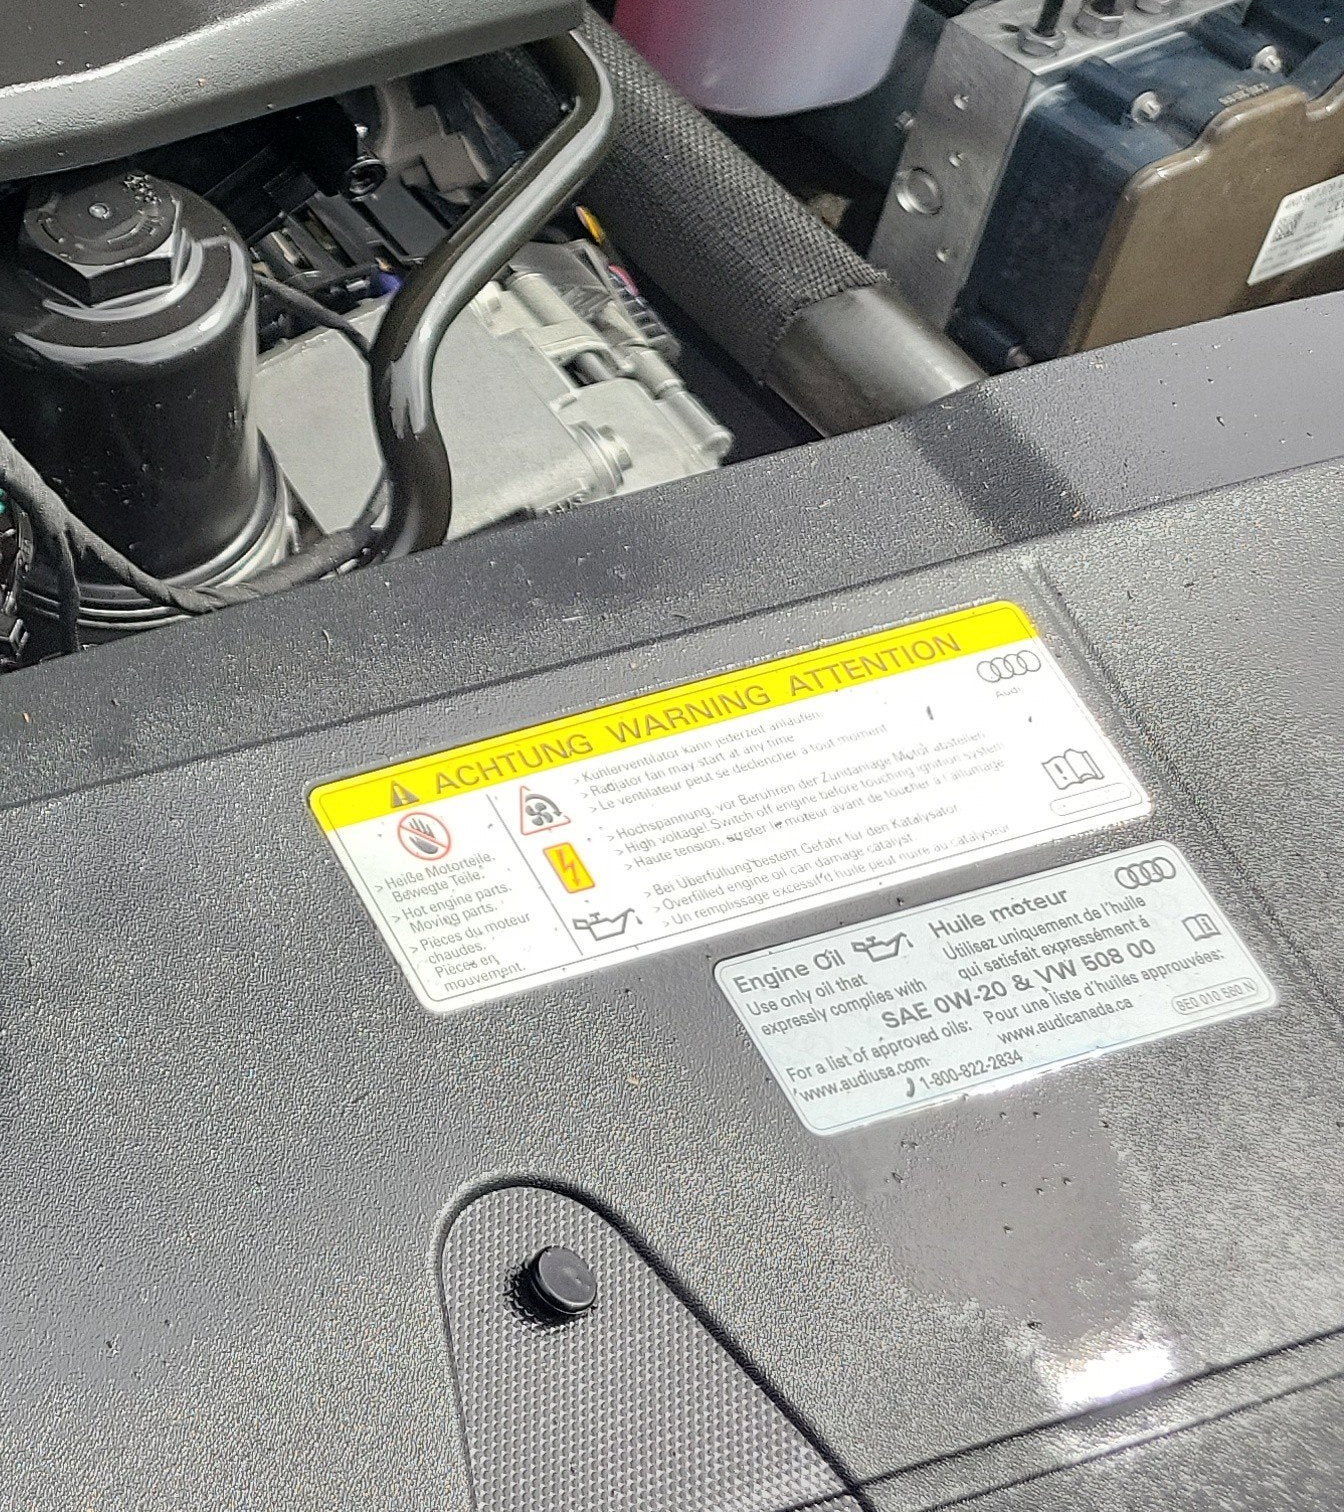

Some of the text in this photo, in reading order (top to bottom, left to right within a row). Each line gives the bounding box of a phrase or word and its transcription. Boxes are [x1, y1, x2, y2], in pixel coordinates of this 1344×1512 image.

[435, 632, 962, 795] ACHTUNG WARNING ATTENTION
[643, 769, 666, 781] fan
[666, 761, 695, 775] may
[696, 751, 726, 767] start
[728, 747, 740, 759] at
[742, 741, 765, 754] any
[597, 799, 616, 811] Le
[684, 771, 714, 790] peut
[714, 767, 730, 779] se
[714, 799, 736, 812] vor
[797, 776, 818, 789] der
[623, 837, 657, 854] High
[657, 821, 711, 844] voltage!
[709, 809, 754, 830] Switch
[755, 802, 774, 817] off
[775, 794, 818, 812] engine
[817, 782, 859, 800] before
[632, 850, 673, 868] Haute
[866, 792, 883, 804] de
[383, 870, 424, 890] Heiße
[390, 866, 486, 903] Bewegte Teile.
[651, 880, 676, 896] Bei
[661, 884, 725, 910] Overfilled
[726, 873, 770, 892] engine
[788, 861, 812, 875] can
[813, 847, 865, 868] damage
[400, 904, 428, 920] Hot
[428, 892, 473, 913] engine
[408, 912, 461, 934] Moving
[463, 925, 484, 939] du
[483, 911, 531, 933] moteur
[669, 912, 692, 925] Un
[926, 888, 1068, 939] Huile moteur
[427, 941, 487, 964] chaudes.
[941, 937, 998, 960] Utilisez
[996, 912, 1084, 946] uniquement
[1082, 906, 1102, 922] de
[731, 948, 846, 994] Engine Oil
[880, 938, 1156, 1029] SAE 0W-20 & VW 508 00
[956, 960, 983, 982] qui
[982, 945, 1042, 972] satisfait
[744, 972, 869, 1016] Use only oil that
[760, 977, 928, 1036] expressly complies with
[981, 1005, 1020, 1025] Pour
[1020, 997, 1050, 1014] une
[1047, 988, 1082, 1006] liste
[1139, 948, 1227, 982] approuvées:
[995, 997, 1134, 1044] www.audicanada.ca
[784, 1019, 973, 1083] For a list of approved oils:
[918, 1048, 1024, 1090] 1-800-822-2834
[794, 1055, 930, 1102] www.audiusa.com
